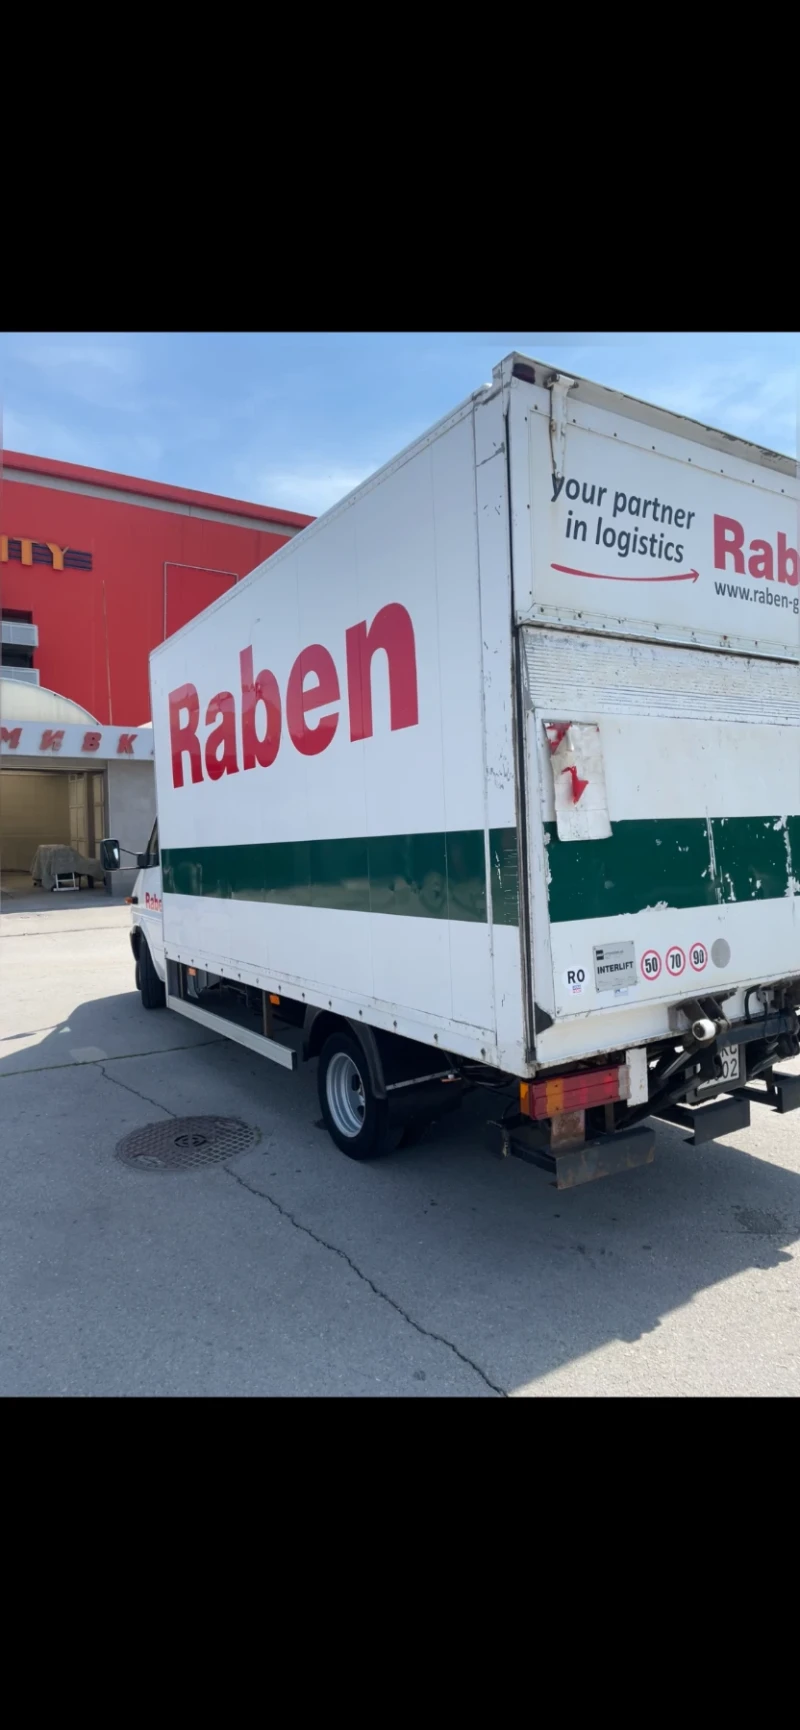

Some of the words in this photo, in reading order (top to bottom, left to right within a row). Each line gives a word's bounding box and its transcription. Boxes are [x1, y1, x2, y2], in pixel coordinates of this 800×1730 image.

[551, 474, 607, 506] your
[612, 490, 695, 529] partner
[565, 510, 588, 542] in
[595, 517, 684, 563] logistics
[713, 513, 799, 587] Rab
[714, 581, 799, 614] www.raben-g
[168, 602, 419, 789] Raben
[0, 727, 154, 755] МИВК
[597, 961, 634, 975] INTERLIFT
[644, 957, 658, 973] 50
[670, 953, 682, 970] 70
[693, 949, 704, 965] 90
[567, 968, 586, 985] RO
